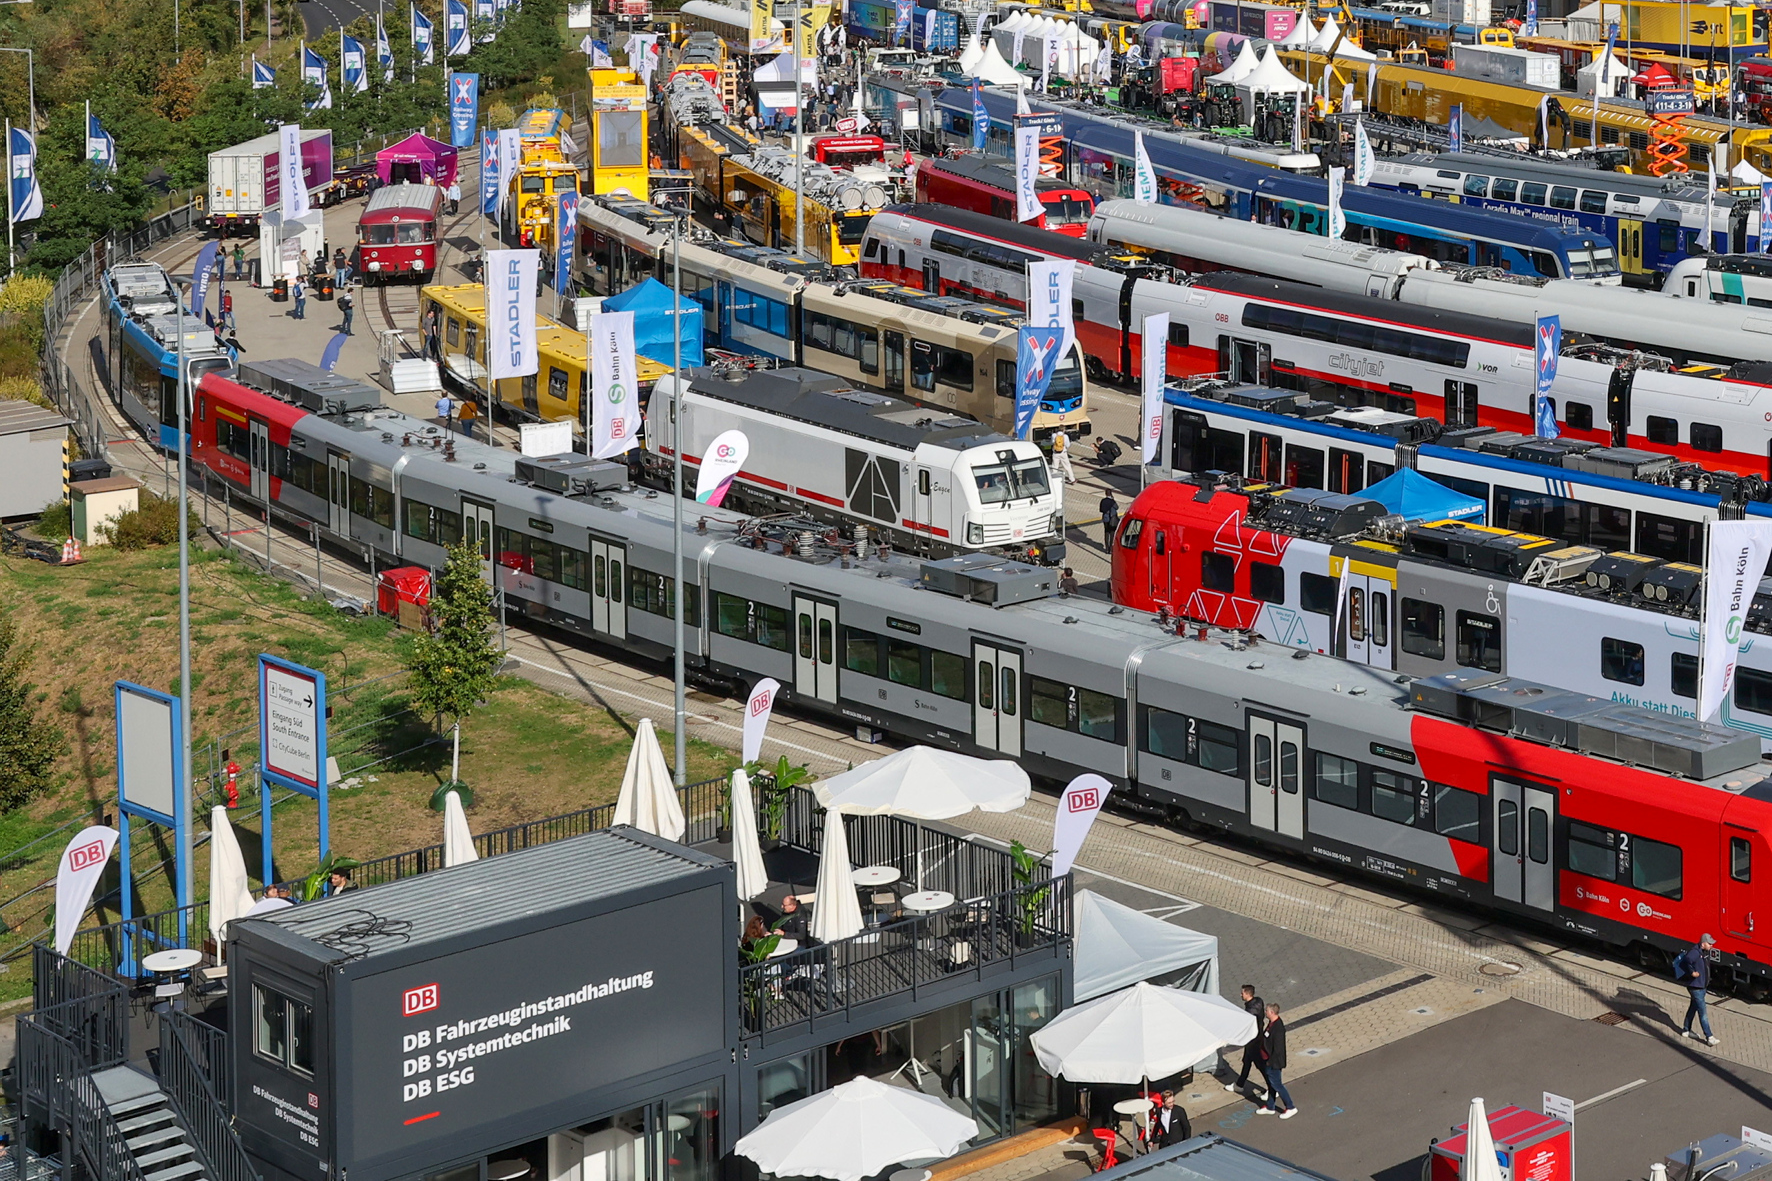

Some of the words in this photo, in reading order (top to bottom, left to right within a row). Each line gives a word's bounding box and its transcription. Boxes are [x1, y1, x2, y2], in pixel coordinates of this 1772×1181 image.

[452, 112, 474, 120] Crossing
[1020, 133, 1034, 213] STADLER
[1561, 213, 1580, 227] train
[506, 259, 522, 368] STADLER
[1215, 312, 1230, 323] ÖBB
[612, 356, 622, 381] Bahn
[1327, 352, 1386, 379] cityjet
[1482, 364, 1499, 374] VOR
[613, 420, 625, 438] DB
[1447, 504, 1484, 518] STADLER
[1736, 546, 1749, 579] Köln
[1730, 580, 1744, 612] Bahn
[278, 682, 293, 696] Zugang
[1068, 685, 1077, 703] 2
[278, 693, 295, 705] Passage
[294, 700, 303, 710] way
[752, 692, 770, 714] DB
[1610, 690, 1640, 709] Akku
[1642, 696, 1669, 714] statt
[1671, 703, 1697, 720] Dies
[272, 709, 293, 727] Eingang
[293, 716, 303, 728] Süd
[1188, 718, 1196, 735] 2
[272, 722, 288, 736] South
[288, 728, 311, 744] Entrance
[278, 741, 298, 757] CityCube
[298, 749, 311, 761] Berlin
[1419, 780, 1429, 798] 2
[1071, 790, 1097, 811] DB
[1619, 832, 1630, 852] 2
[74, 843, 103, 868] DB
[1586, 889, 1599, 901] Bahn
[1598, 893, 1611, 904] Köln
[1652, 910, 1672, 920] RHEINLAND
[406, 986, 438, 1012] DB
[402, 1029, 431, 1054] DB
[435, 969, 654, 1046] Fahrzeuginstandhaltung
[402, 1054, 431, 1079] DB
[435, 1015, 572, 1072] Systemtechnik
[402, 1079, 431, 1103] DB
[435, 1067, 475, 1094] ESG
[253, 1084, 261, 1097] DB
[261, 1087, 320, 1124] Fahrzeuginstandhaltung
[282, 1110, 320, 1137] Systemtechnik
[307, 1134, 320, 1149] ESG
